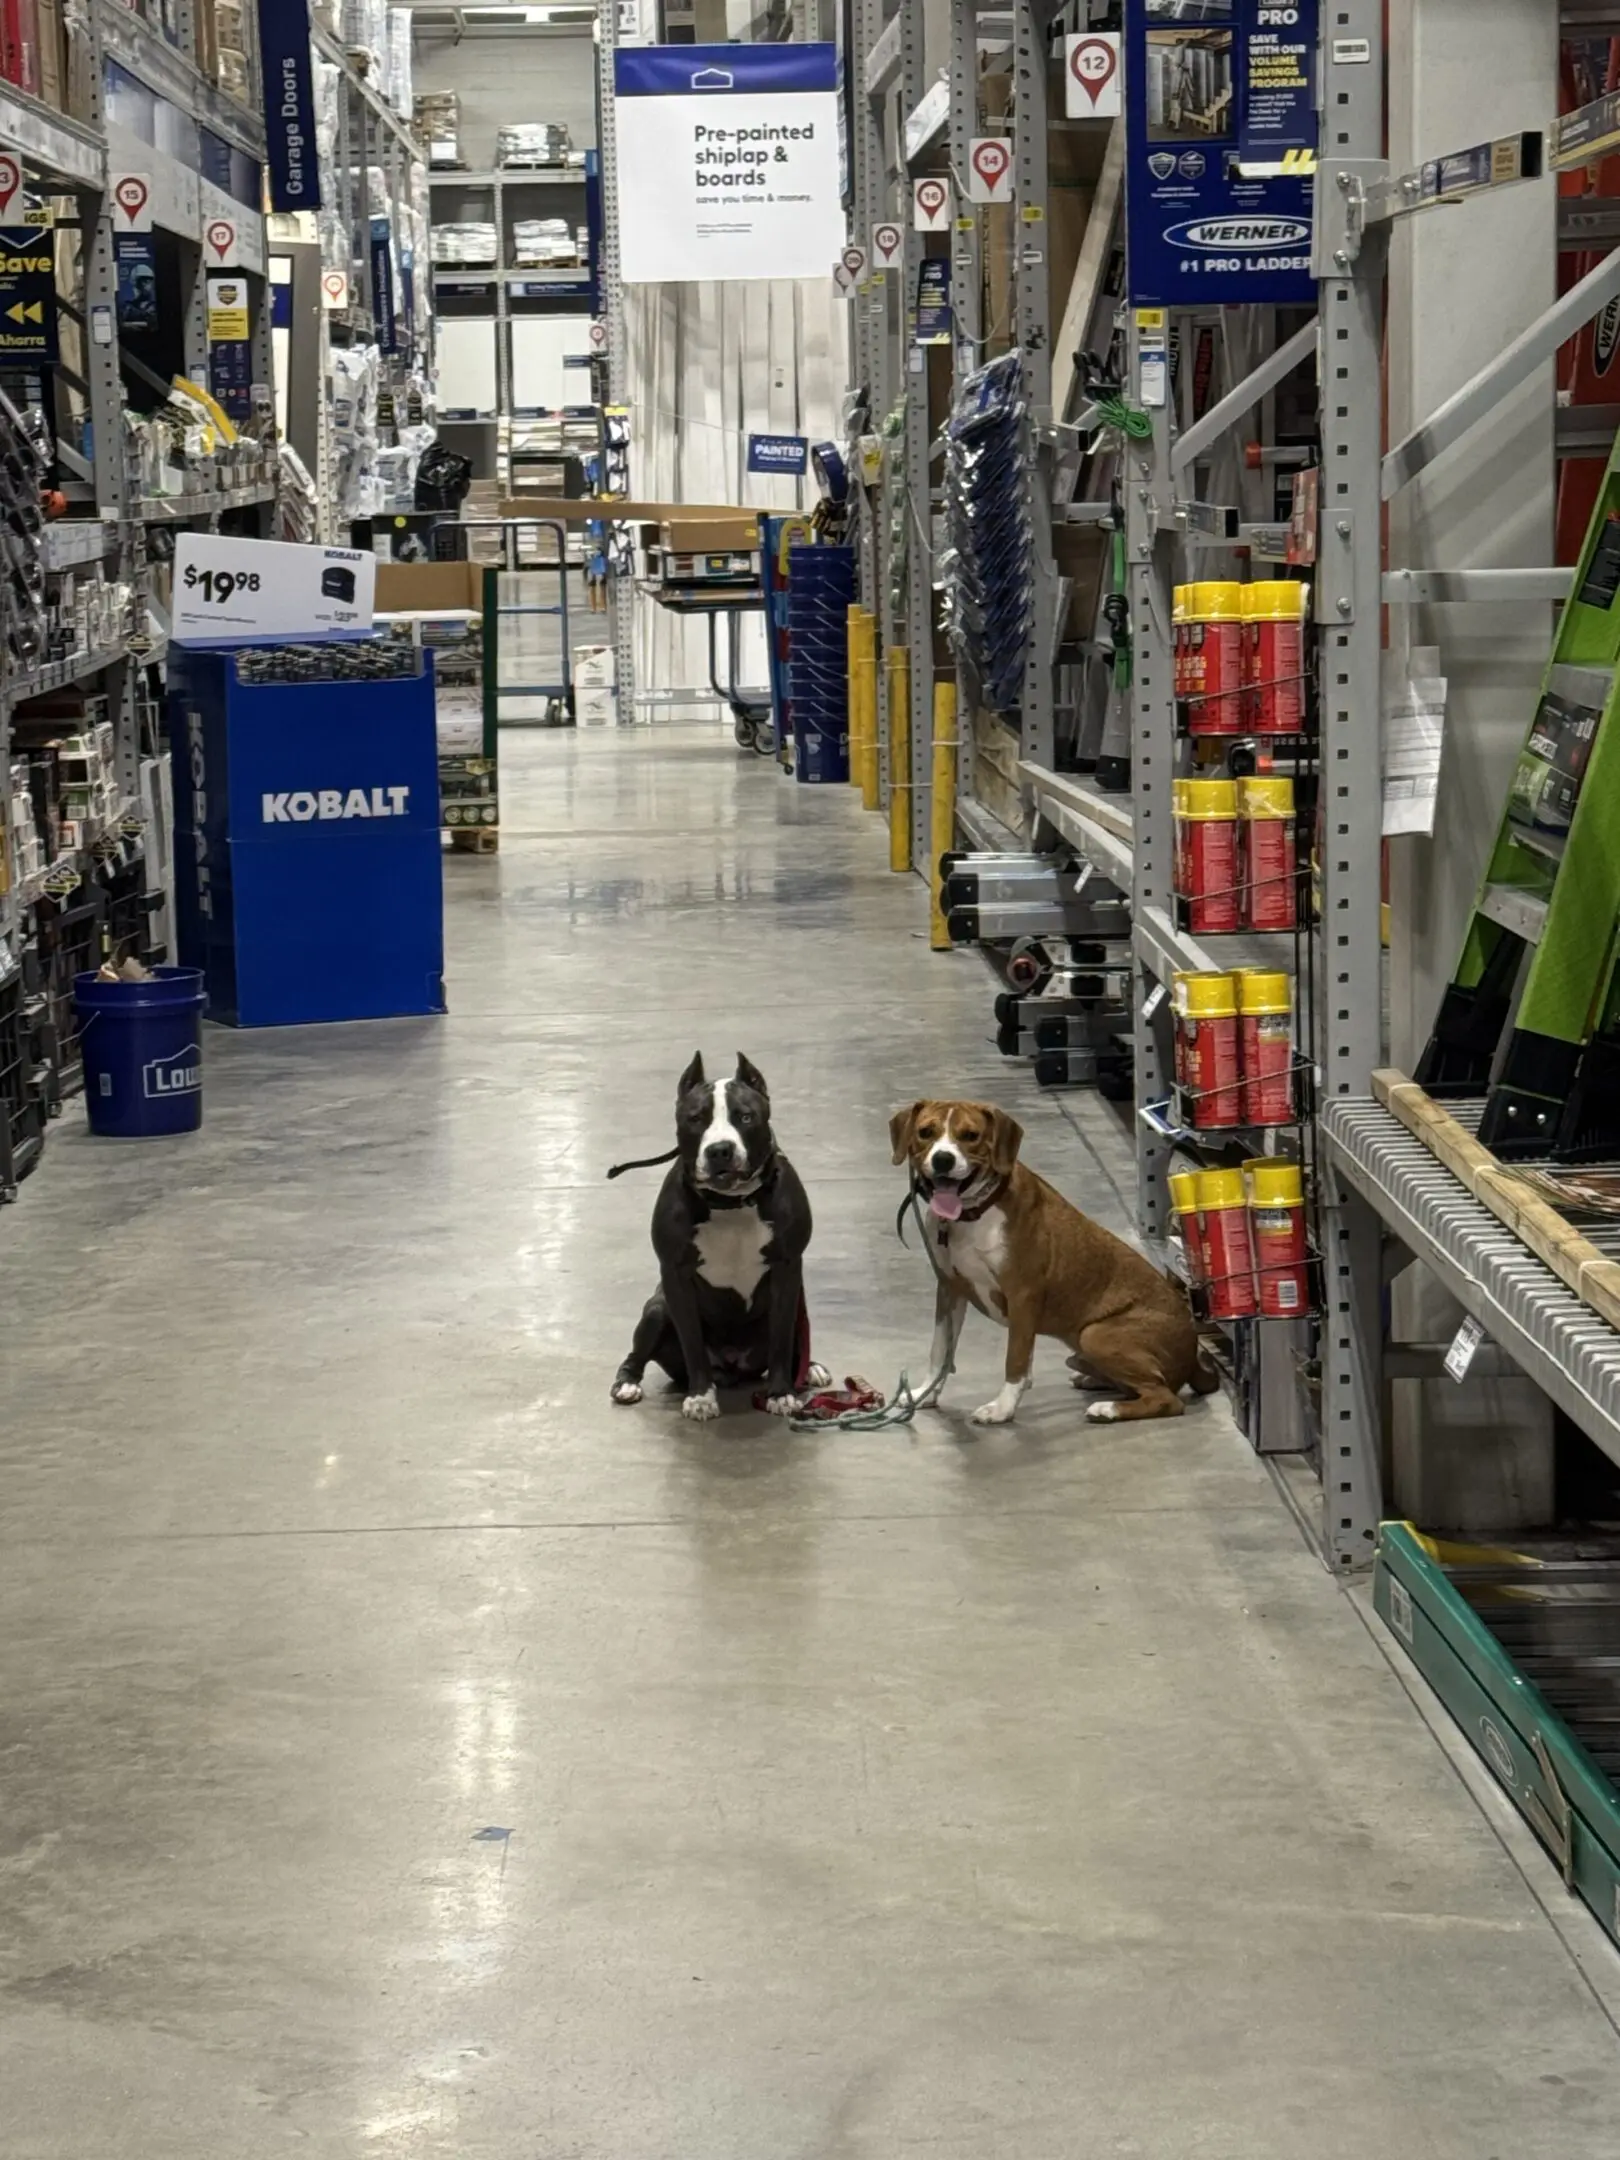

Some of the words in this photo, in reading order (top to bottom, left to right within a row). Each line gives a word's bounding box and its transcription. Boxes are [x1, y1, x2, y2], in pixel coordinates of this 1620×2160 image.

[1258, 9, 1299, 26] PRO
[1249, 34, 1278, 44] SAVE
[1249, 45, 1281, 55] WITH
[1281, 44, 1307, 54] OUR
[1082, 56, 1106, 70] 12
[1249, 55, 1298, 66] VOLUME
[1249, 67, 1299, 77] SAVINGS
[281, 57, 299, 117] Doors
[1249, 78, 1308, 88] PROGRAM
[695, 122, 815, 145] Pre-painted
[286, 123, 305, 195] Garage
[695, 146, 769, 167] shiplap
[774, 145, 789, 162] &
[982, 156, 999, 167] 14
[696, 169, 767, 187] boards
[124, 190, 139, 200] 15
[924, 192, 939, 202] 16
[215, 231, 226, 241] 17
[1200, 225, 1298, 241] WERNER
[0, 255, 53, 273] Save
[1180, 259, 1199, 273] #1
[1205, 258, 1241, 272] PRO
[0, 334, 46, 347] Ahorra
[755, 444, 804, 457] PAINTED
[324, 551, 363, 561] KOBALT
[262, 786, 409, 823] KOBALT
